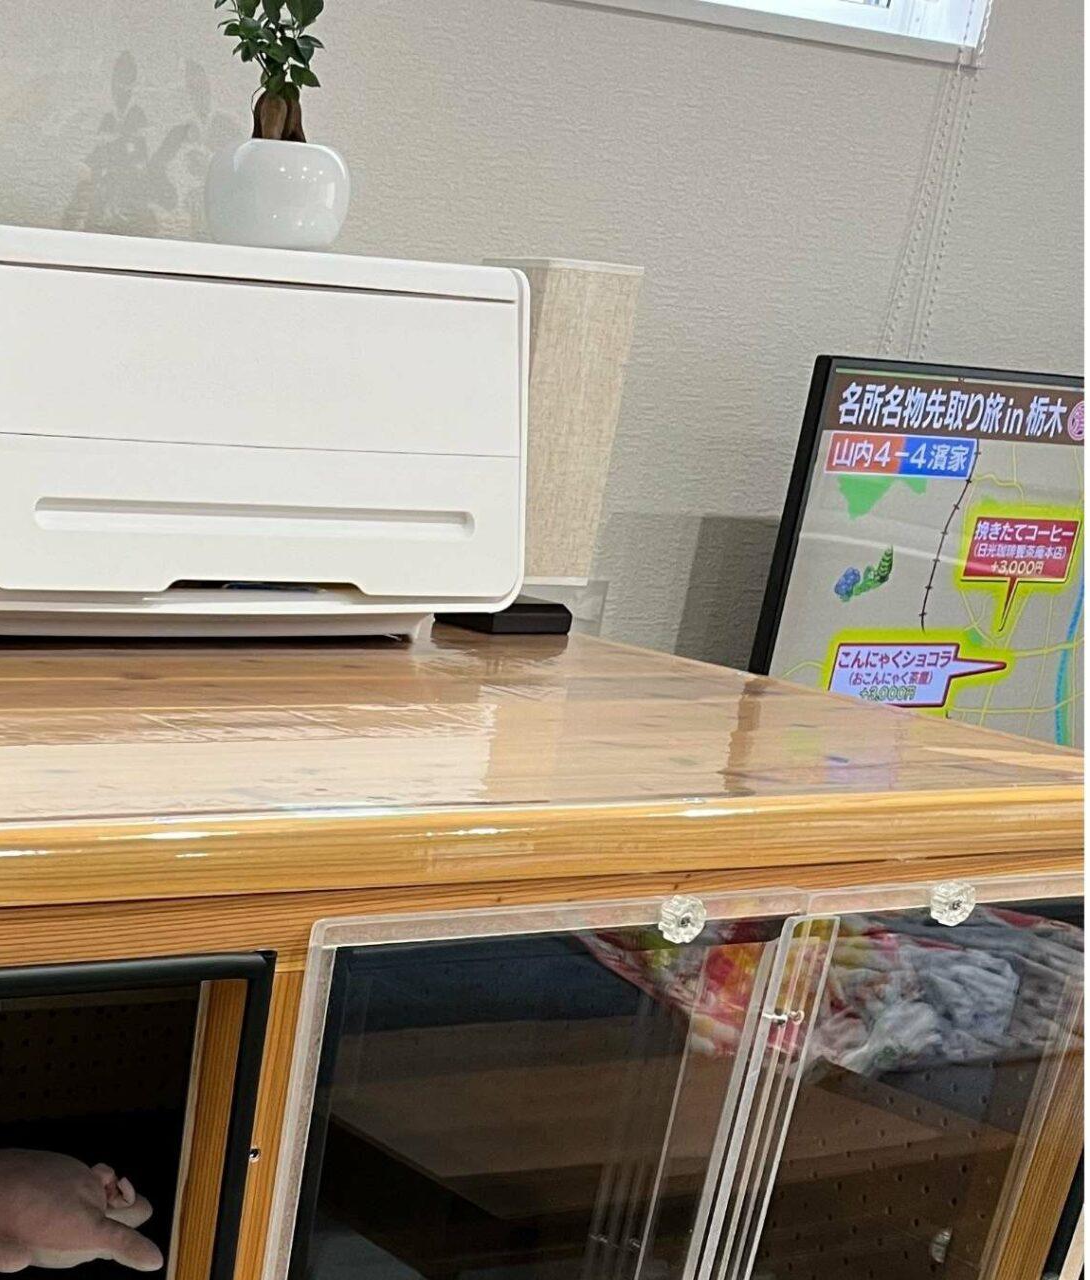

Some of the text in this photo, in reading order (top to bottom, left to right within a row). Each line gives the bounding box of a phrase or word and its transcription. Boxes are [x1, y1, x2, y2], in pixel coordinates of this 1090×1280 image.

[838, 650, 952, 669] こんにゃくショコラ
